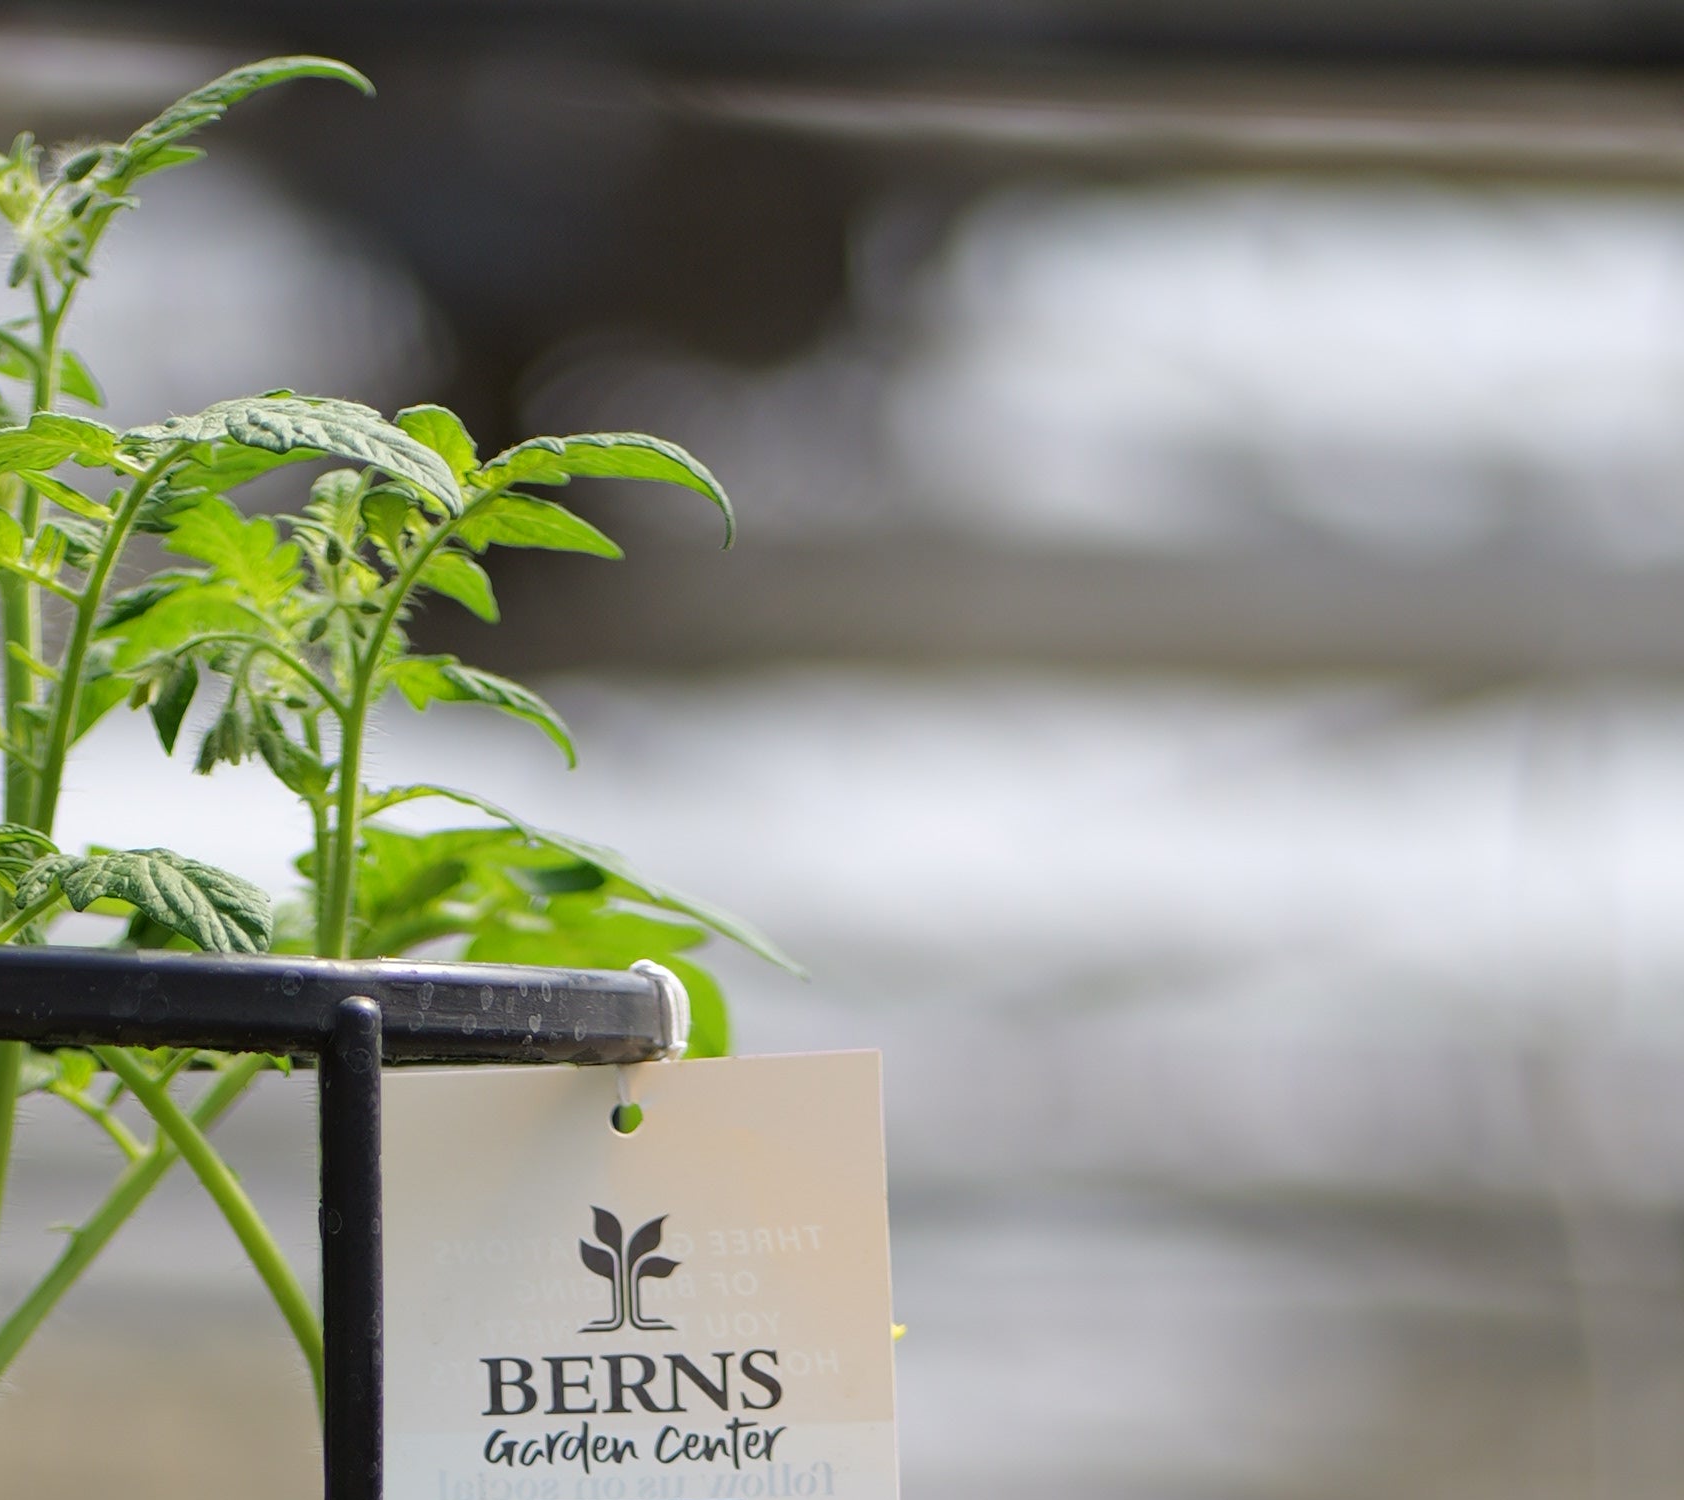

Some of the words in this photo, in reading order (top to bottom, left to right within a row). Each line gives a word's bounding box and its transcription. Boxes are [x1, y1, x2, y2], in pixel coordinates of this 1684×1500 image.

[479, 1349, 783, 1417] BERNS
[483, 1421, 639, 1475] Garden
[654, 1416, 787, 1470] Center
